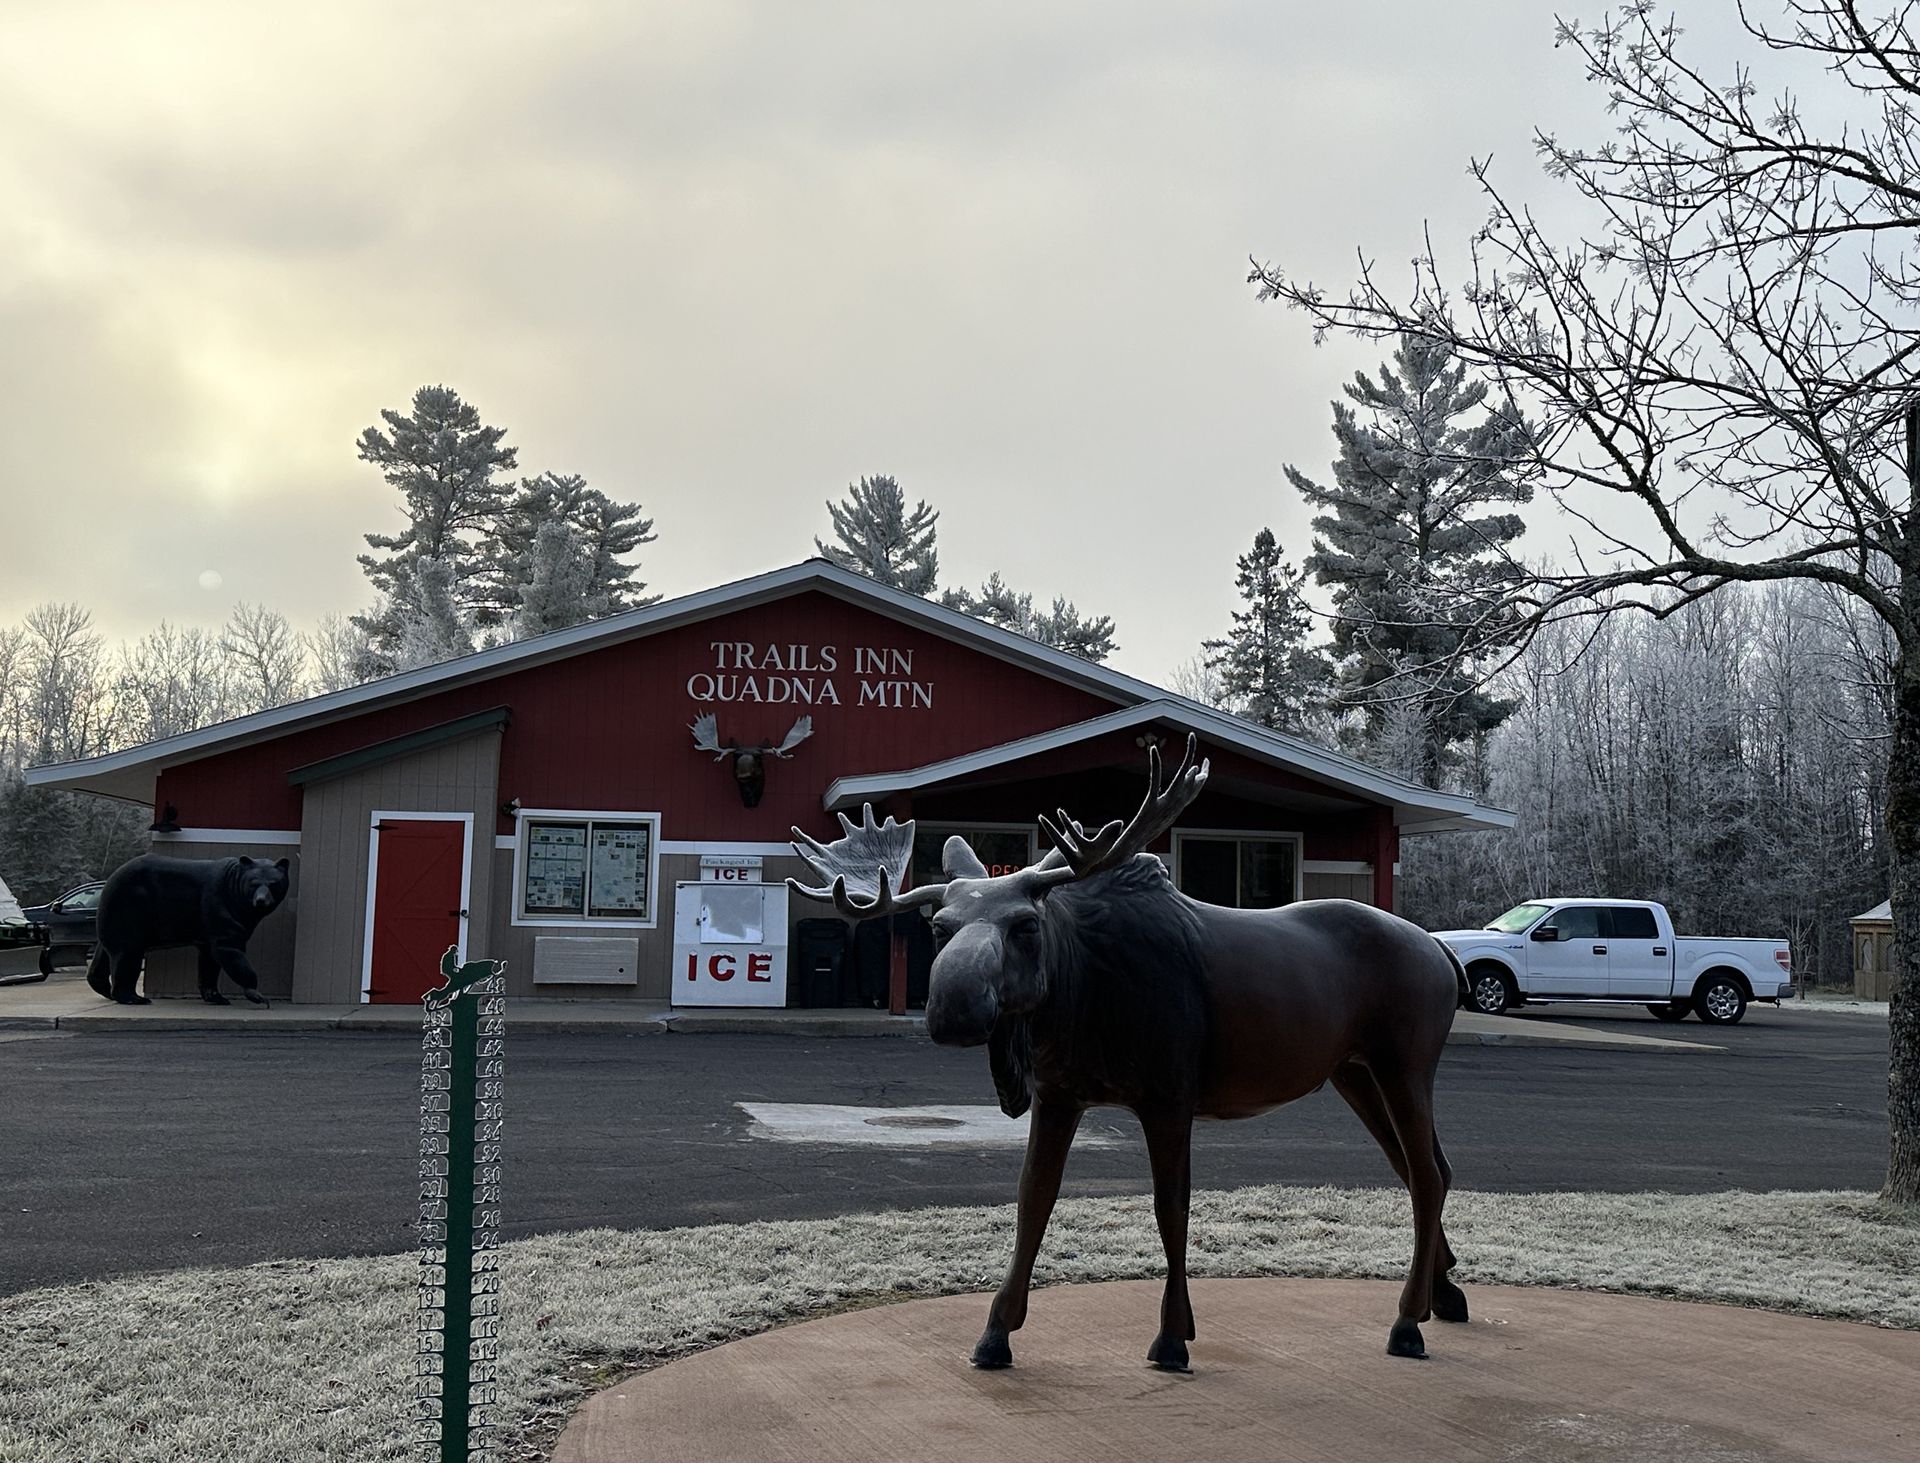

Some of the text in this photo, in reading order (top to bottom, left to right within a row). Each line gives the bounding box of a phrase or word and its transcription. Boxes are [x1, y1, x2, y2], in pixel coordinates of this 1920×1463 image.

[710, 641, 914, 676] TRAILS INN
[686, 673, 935, 709] QUADNA MTN
[714, 868, 749, 881] ICE
[688, 950, 773, 983] ICE
[485, 998, 505, 1014] 46
[485, 1019, 505, 1035] 44
[423, 1032, 441, 1048] 43
[484, 1040, 504, 1056] 42
[422, 1052, 441, 1069] 41
[485, 1060, 504, 1076] 40
[421, 1073, 441, 1090] 39
[484, 1082, 503, 1098] 38
[421, 1094, 441, 1112] 37
[483, 1103, 503, 1119] 36
[420, 1115, 440, 1133] 35
[482, 1123, 503, 1140] 34
[420, 1137, 439, 1155] 33
[482, 1145, 503, 1162] 32
[419, 1159, 438, 1176] 31
[482, 1167, 502, 1183] 30
[419, 1181, 439, 1198] 29
[482, 1186, 501, 1202] 28
[419, 1202, 440, 1219] 27
[481, 1210, 501, 1226] 26
[419, 1226, 439, 1242] 25
[481, 1231, 500, 1248] 24
[419, 1248, 437, 1265] 23
[481, 1255, 499, 1271] 22
[417, 1270, 435, 1287] 21
[482, 1277, 499, 1293] 20
[417, 1292, 433, 1309] 19
[482, 1299, 498, 1315] 18
[417, 1314, 433, 1331] 17
[482, 1321, 498, 1337] 16
[416, 1336, 433, 1353] 15
[481, 1342, 498, 1360] 14
[416, 1359, 432, 1376] 13
[480, 1365, 496, 1382] 12
[415, 1381, 430, 1398] 11
[480, 1387, 496, 1404] 10
[424, 1403, 432, 1419] 9
[479, 1411, 486, 1426] 8
[425, 1425, 433, 1440] 7
[478, 1432, 486, 1448] 6
[423, 1448, 431, 1463] 5
